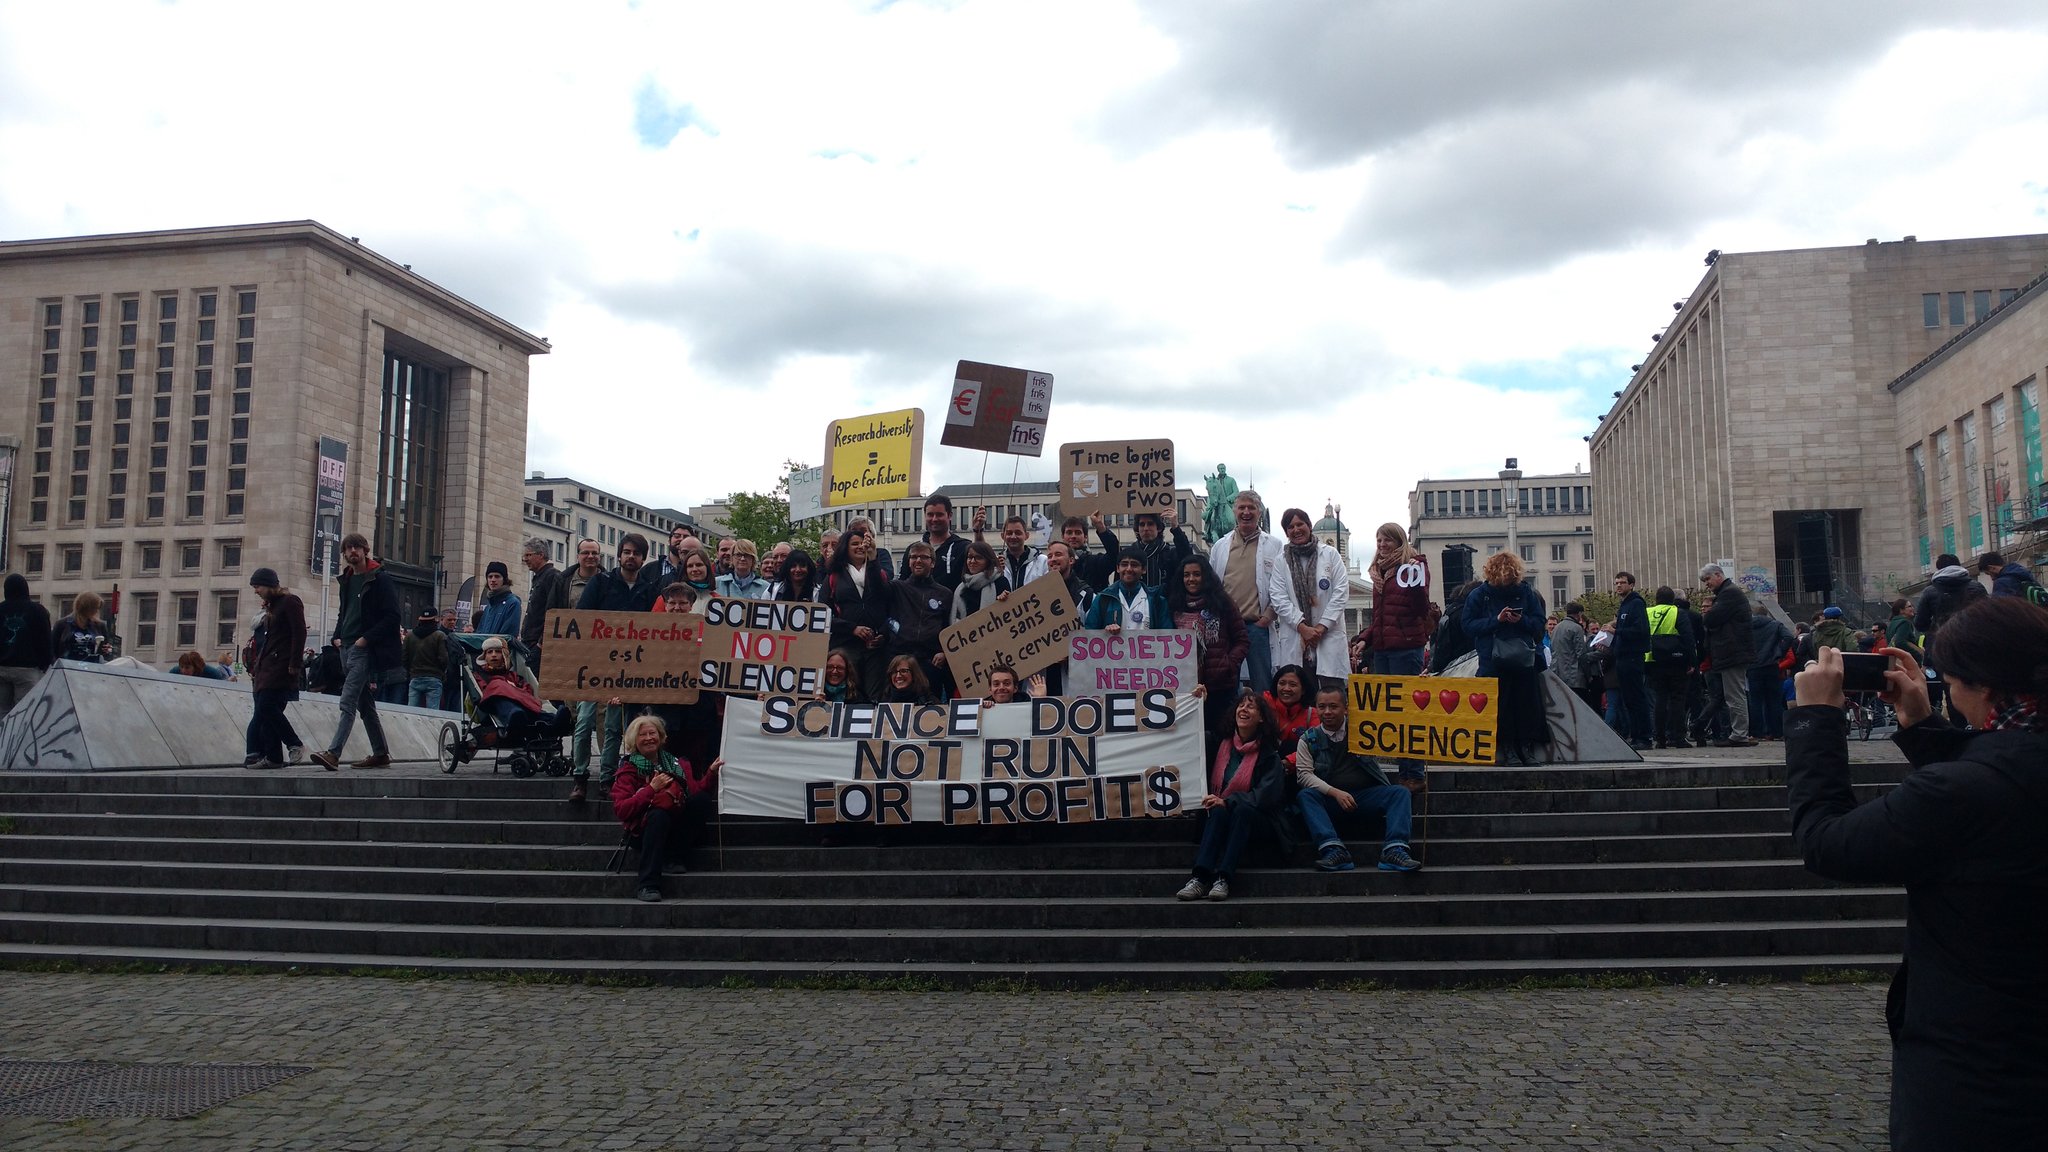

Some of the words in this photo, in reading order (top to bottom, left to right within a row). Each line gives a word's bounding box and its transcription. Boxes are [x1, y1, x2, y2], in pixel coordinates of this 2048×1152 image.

[1030, 388, 1045, 399] fnrs
[1032, 376, 1047, 388] fnrs
[1028, 401, 1043, 413] fnrs
[1011, 425, 1041, 446] fnrs
[322, 459, 343, 478] OFF
[1070, 449, 1120, 466] Time
[829, 475, 858, 498] hope
[1105, 473, 1123, 492] to
[1127, 469, 1174, 488] FNRS
[1126, 489, 1173, 508] FWO
[553, 616, 581, 640] LA
[946, 594, 1040, 653] Chercheurs
[1010, 611, 1044, 639] sans
[731, 631, 797, 662] NOT
[1018, 617, 1084, 660] cerveaux
[1072, 634, 1192, 660] SOCIETY
[1096, 666, 1179, 690] NEEDS
[1354, 681, 1403, 712] WE
[761, 696, 982, 739] SCIENCE
[1031, 688, 1176, 736] DOES
[1358, 720, 1492, 761] SCIENCE
[854, 740, 962, 780] NOT
[984, 736, 1098, 779] RUN
[805, 781, 911, 824] FOR
